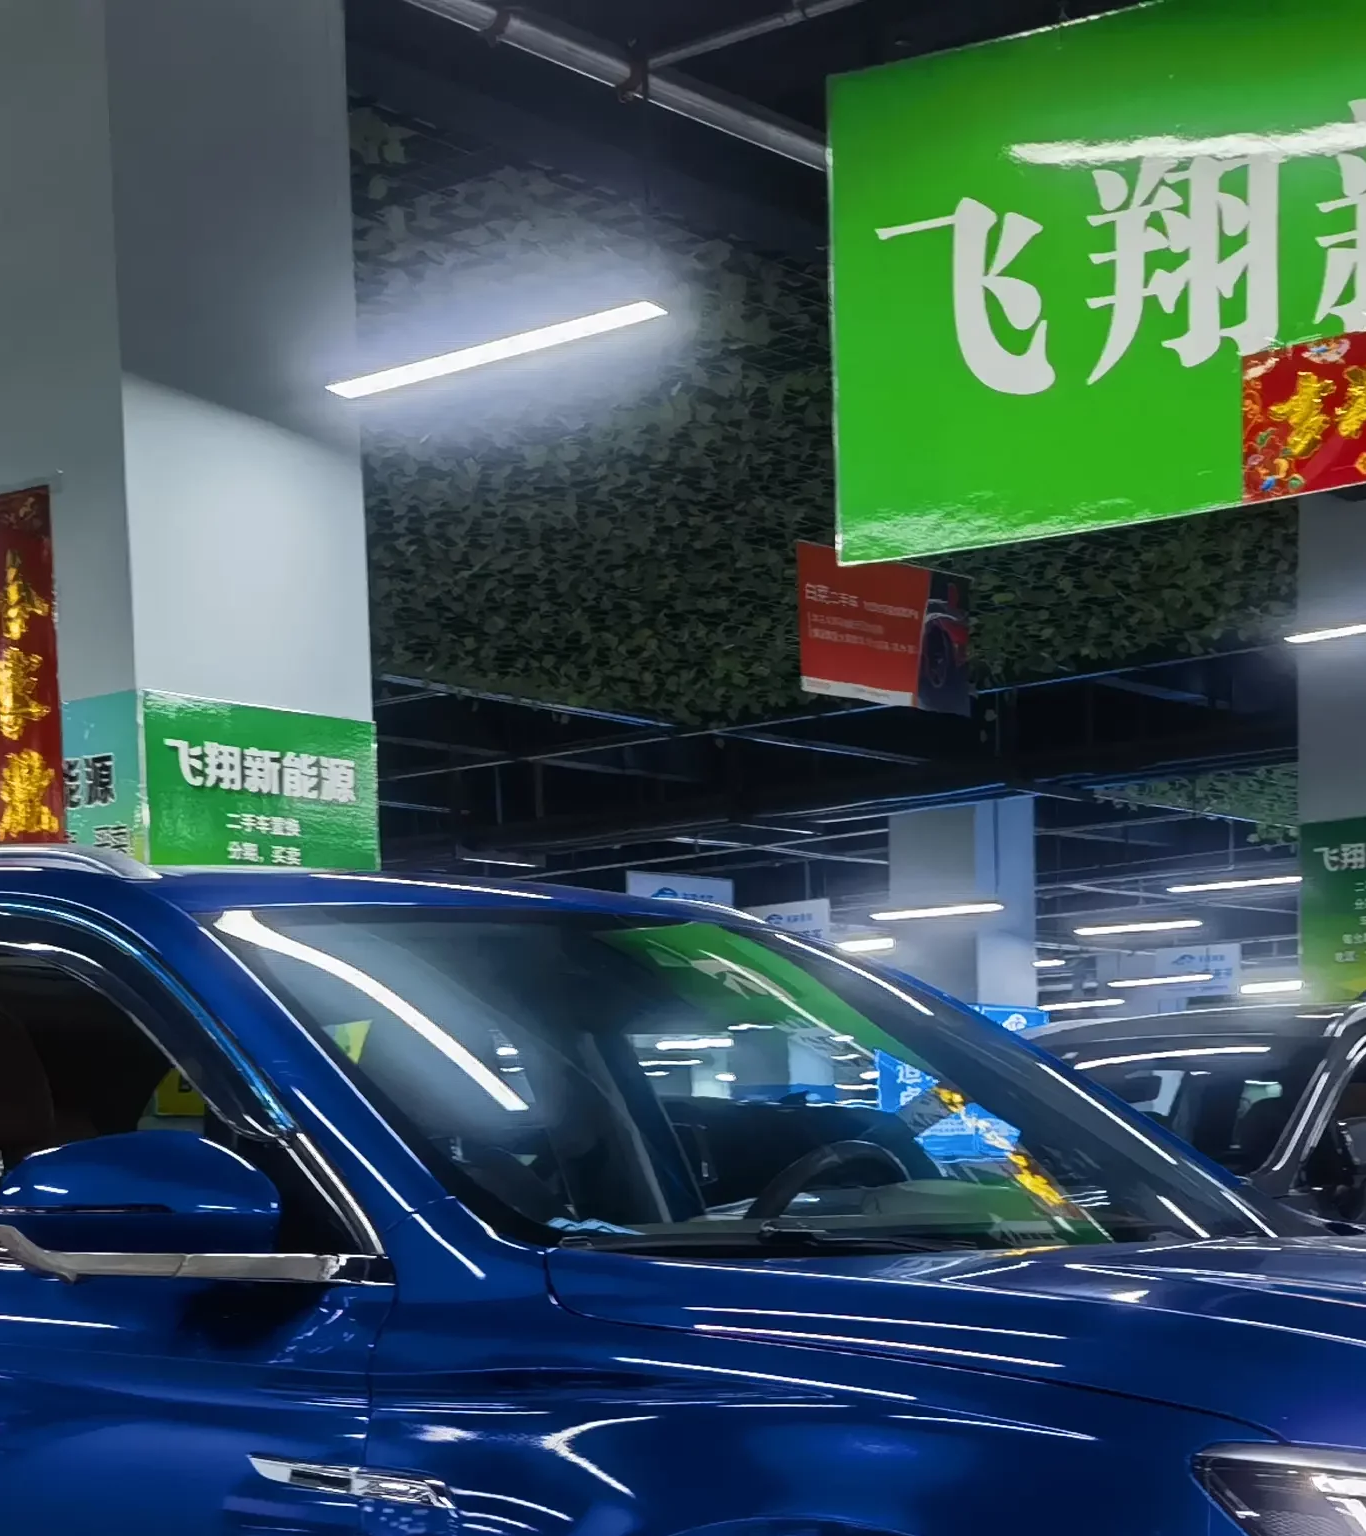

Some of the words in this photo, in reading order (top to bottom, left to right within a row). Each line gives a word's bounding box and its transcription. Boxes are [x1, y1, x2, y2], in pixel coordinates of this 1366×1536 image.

[163, 737, 357, 803] 飞翔新能源
